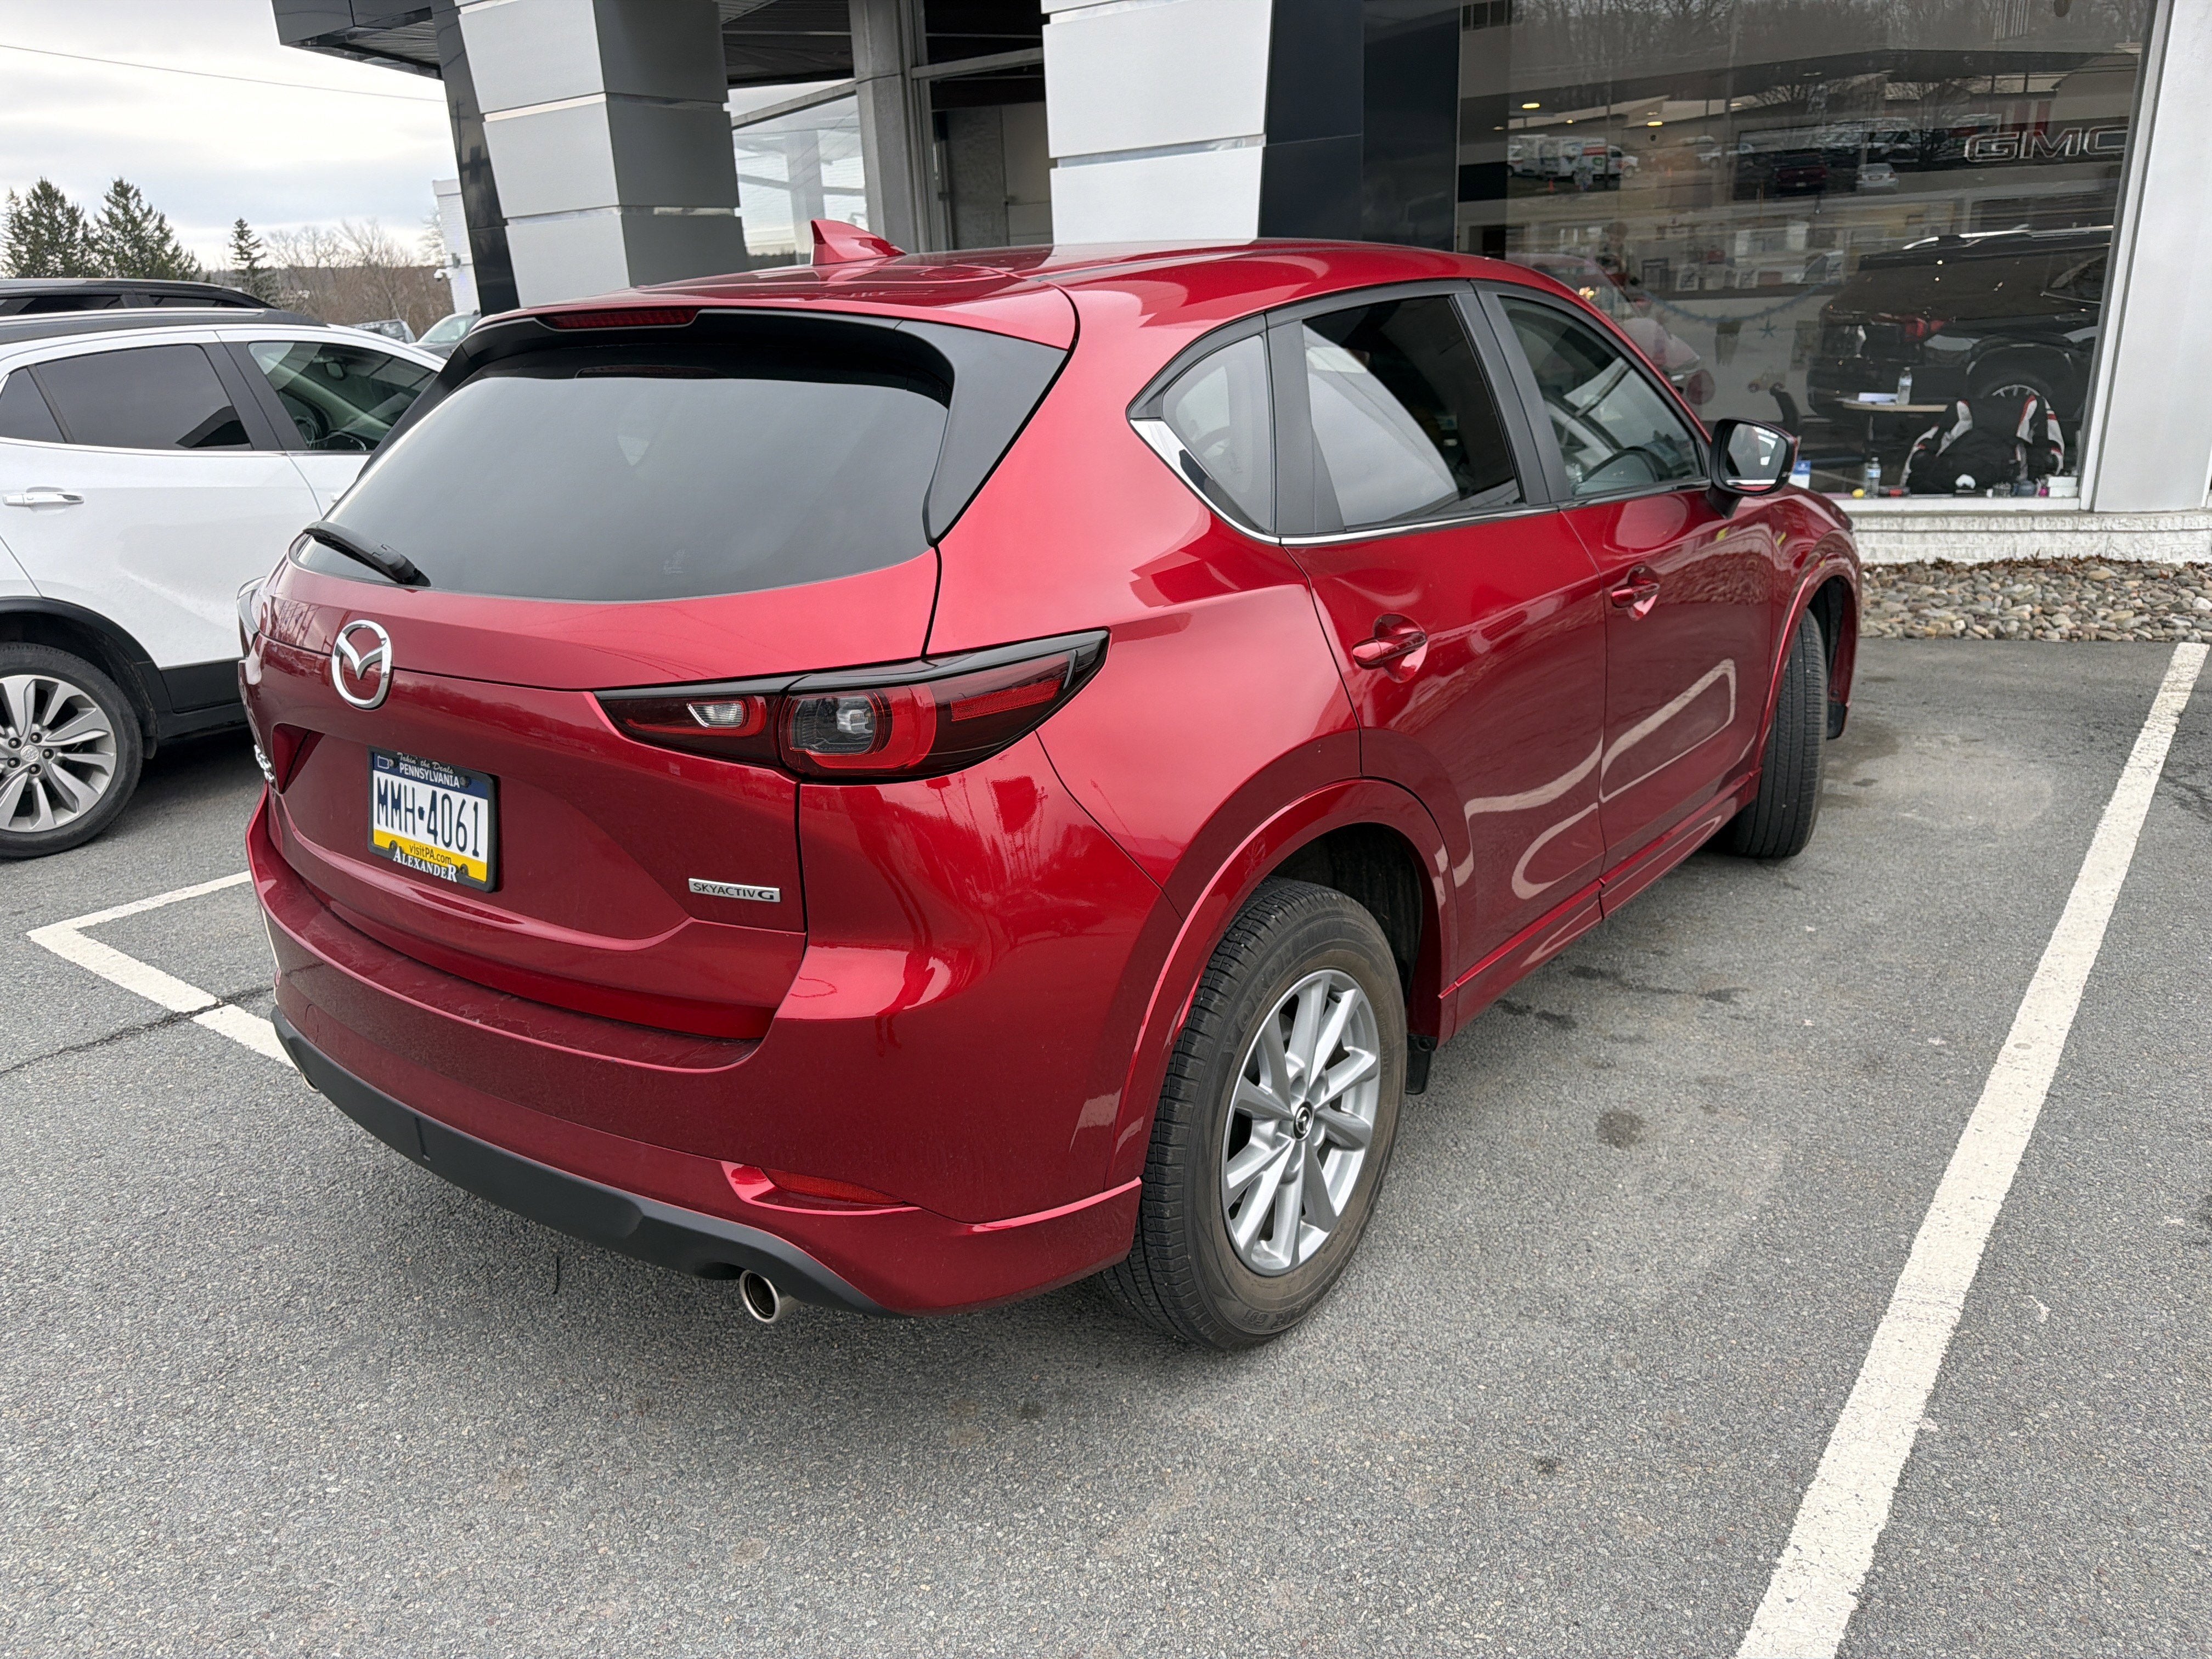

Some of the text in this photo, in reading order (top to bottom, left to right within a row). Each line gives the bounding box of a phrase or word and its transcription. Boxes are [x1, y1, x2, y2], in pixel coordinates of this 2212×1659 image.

[1965, 125, 2129, 162] GMC
[399, 762, 460, 788] PENNSYLVANIA
[393, 846, 458, 883] ALEXANDER
[409, 843, 452, 865] visitPA.com
